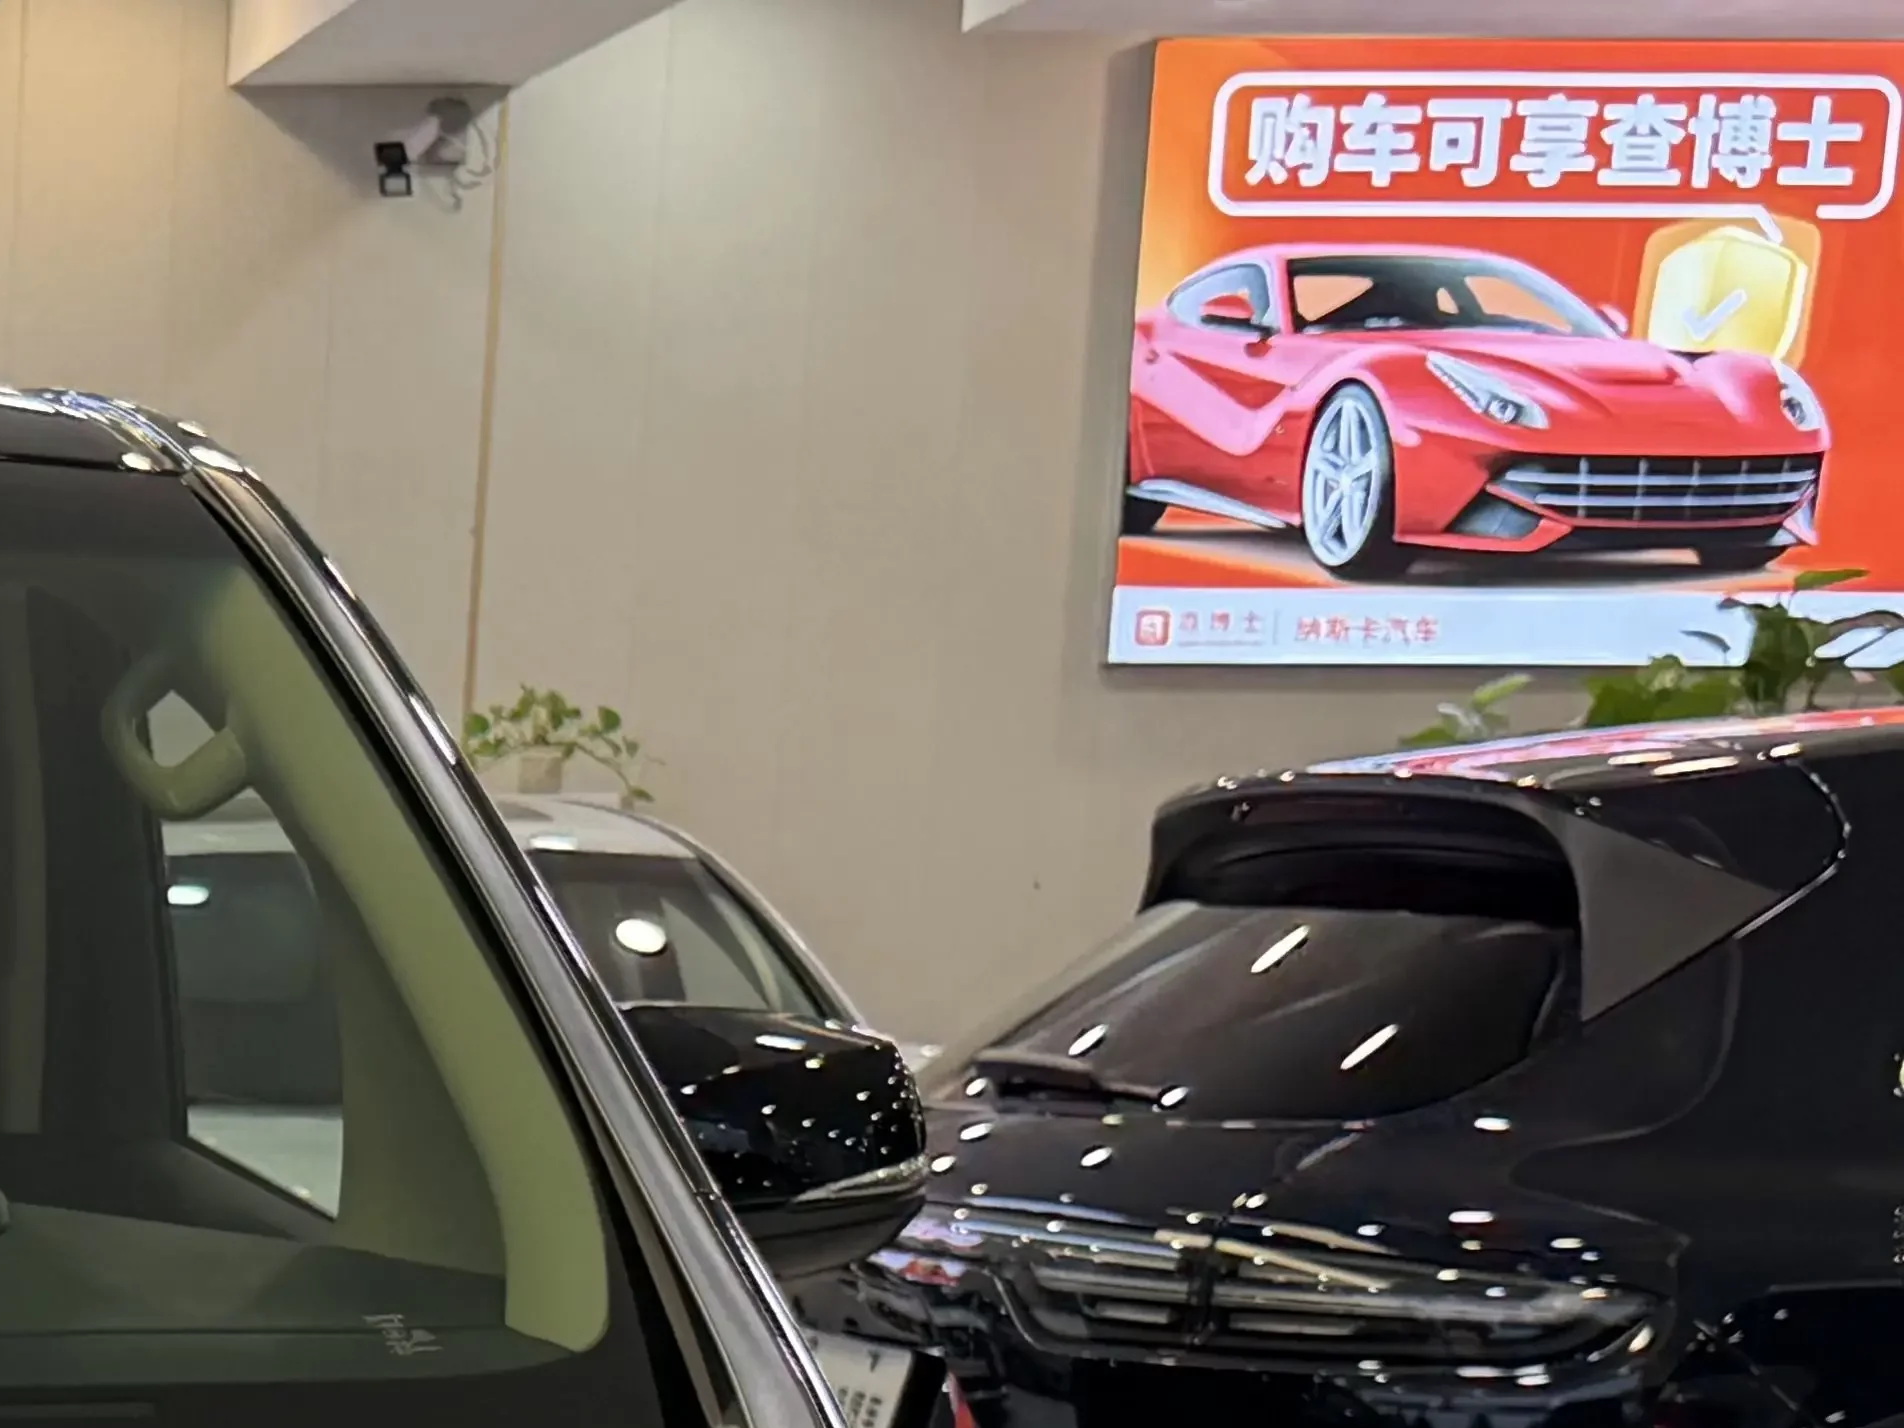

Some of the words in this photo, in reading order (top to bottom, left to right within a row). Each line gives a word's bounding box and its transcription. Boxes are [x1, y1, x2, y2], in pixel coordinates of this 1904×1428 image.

[1245, 93, 1865, 188] 购车可享查博士
